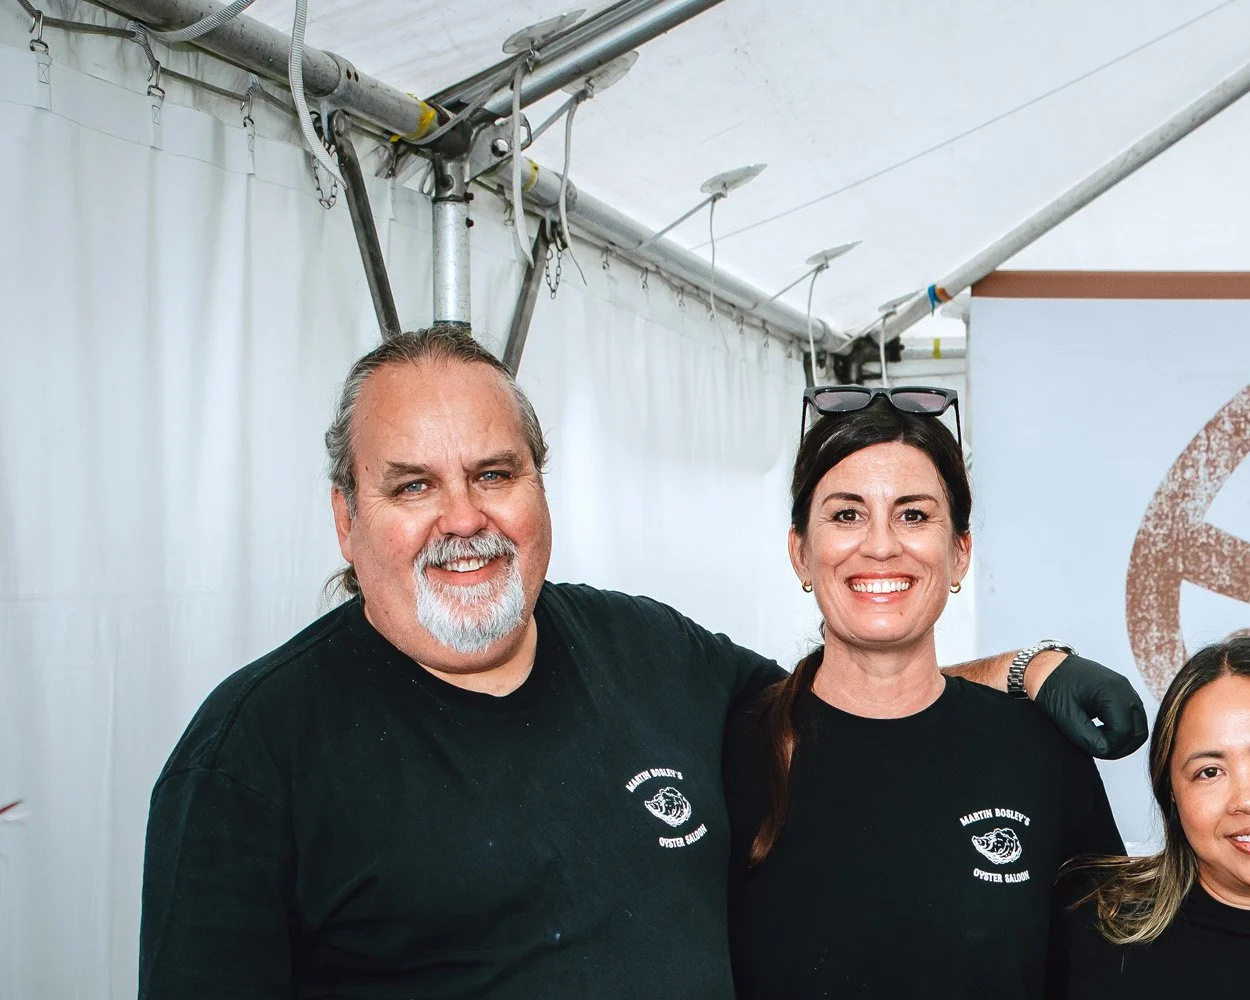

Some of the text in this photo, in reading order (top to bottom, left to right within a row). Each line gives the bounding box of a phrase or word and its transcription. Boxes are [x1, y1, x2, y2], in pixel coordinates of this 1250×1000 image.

[625, 770, 652, 793] MARTIN
[959, 808, 1031, 826] MARTIN BOSLEY'S
[658, 823, 708, 849] OYSTER SALOON
[973, 867, 1031, 884] OYSTER SALOON
